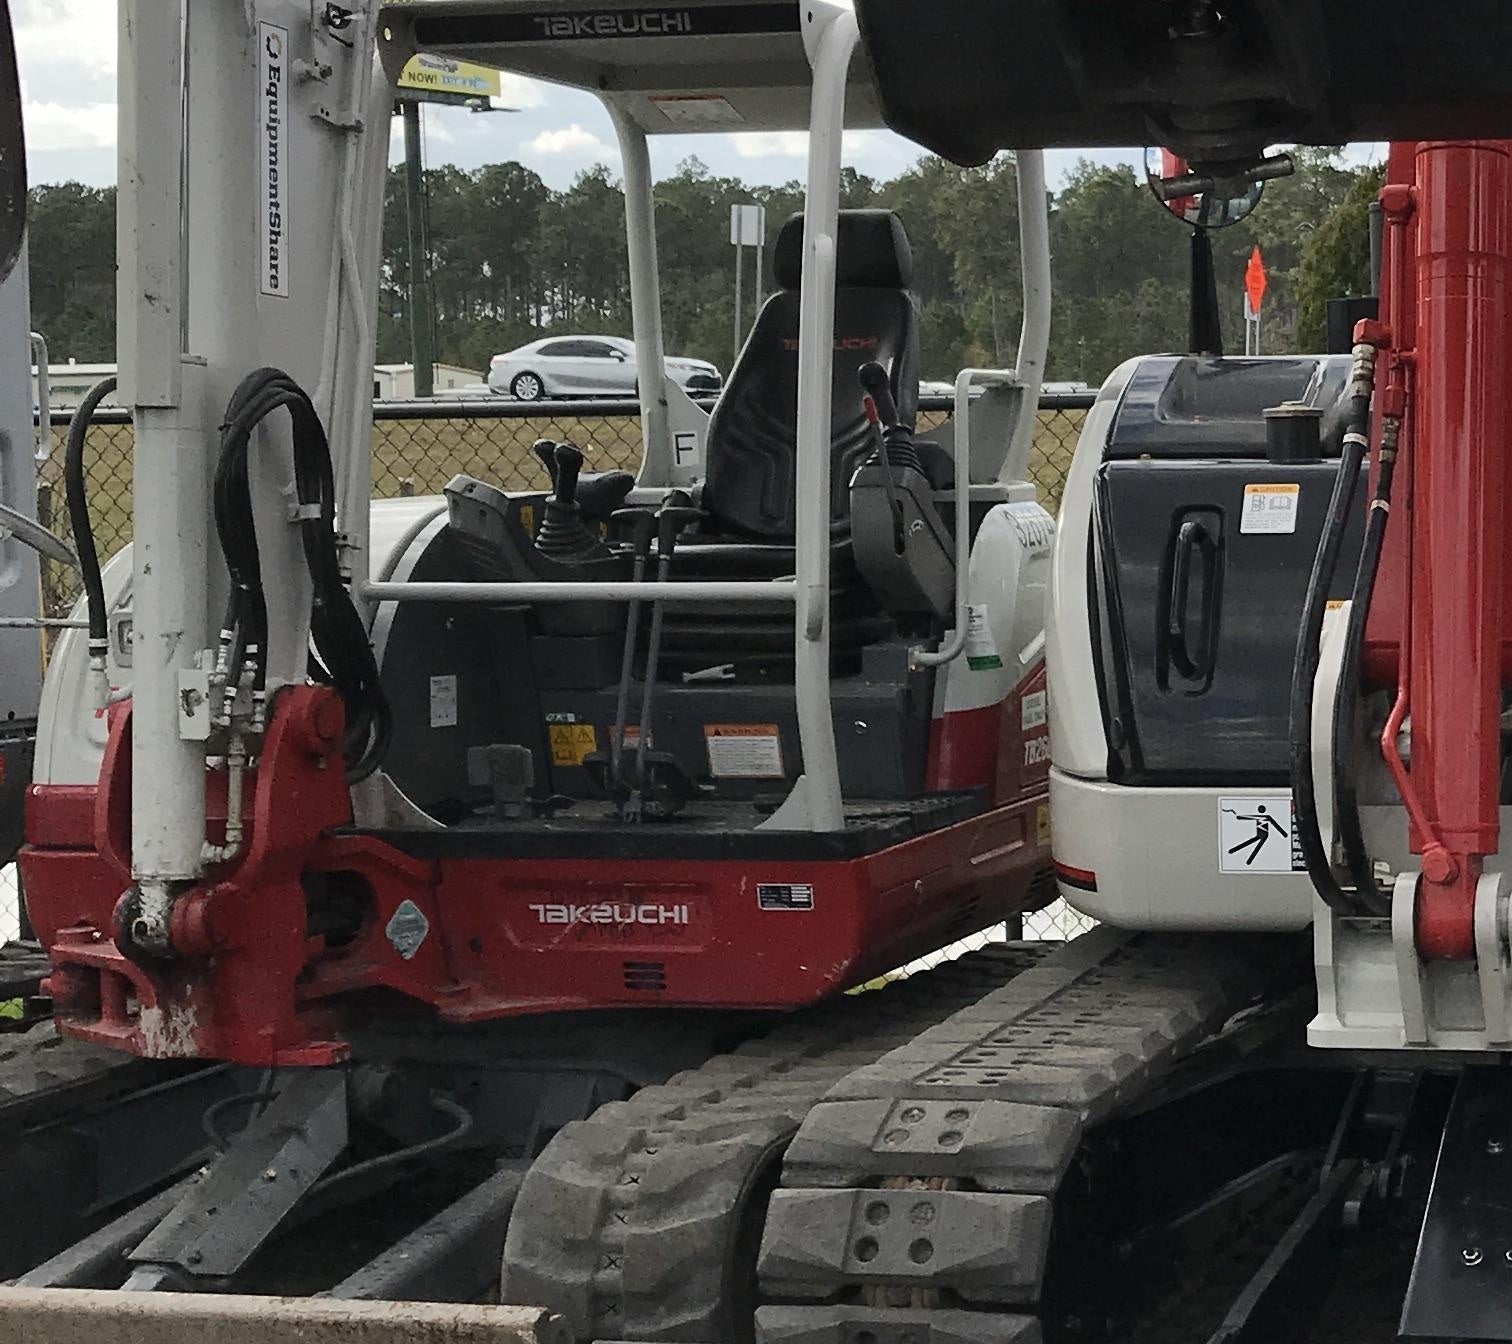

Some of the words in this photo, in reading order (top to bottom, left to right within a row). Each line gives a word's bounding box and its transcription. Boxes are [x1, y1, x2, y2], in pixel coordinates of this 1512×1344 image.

[408, 71, 438, 84] NOW!
[266, 62, 282, 290] EquipmentShare
[675, 433, 695, 465] F
